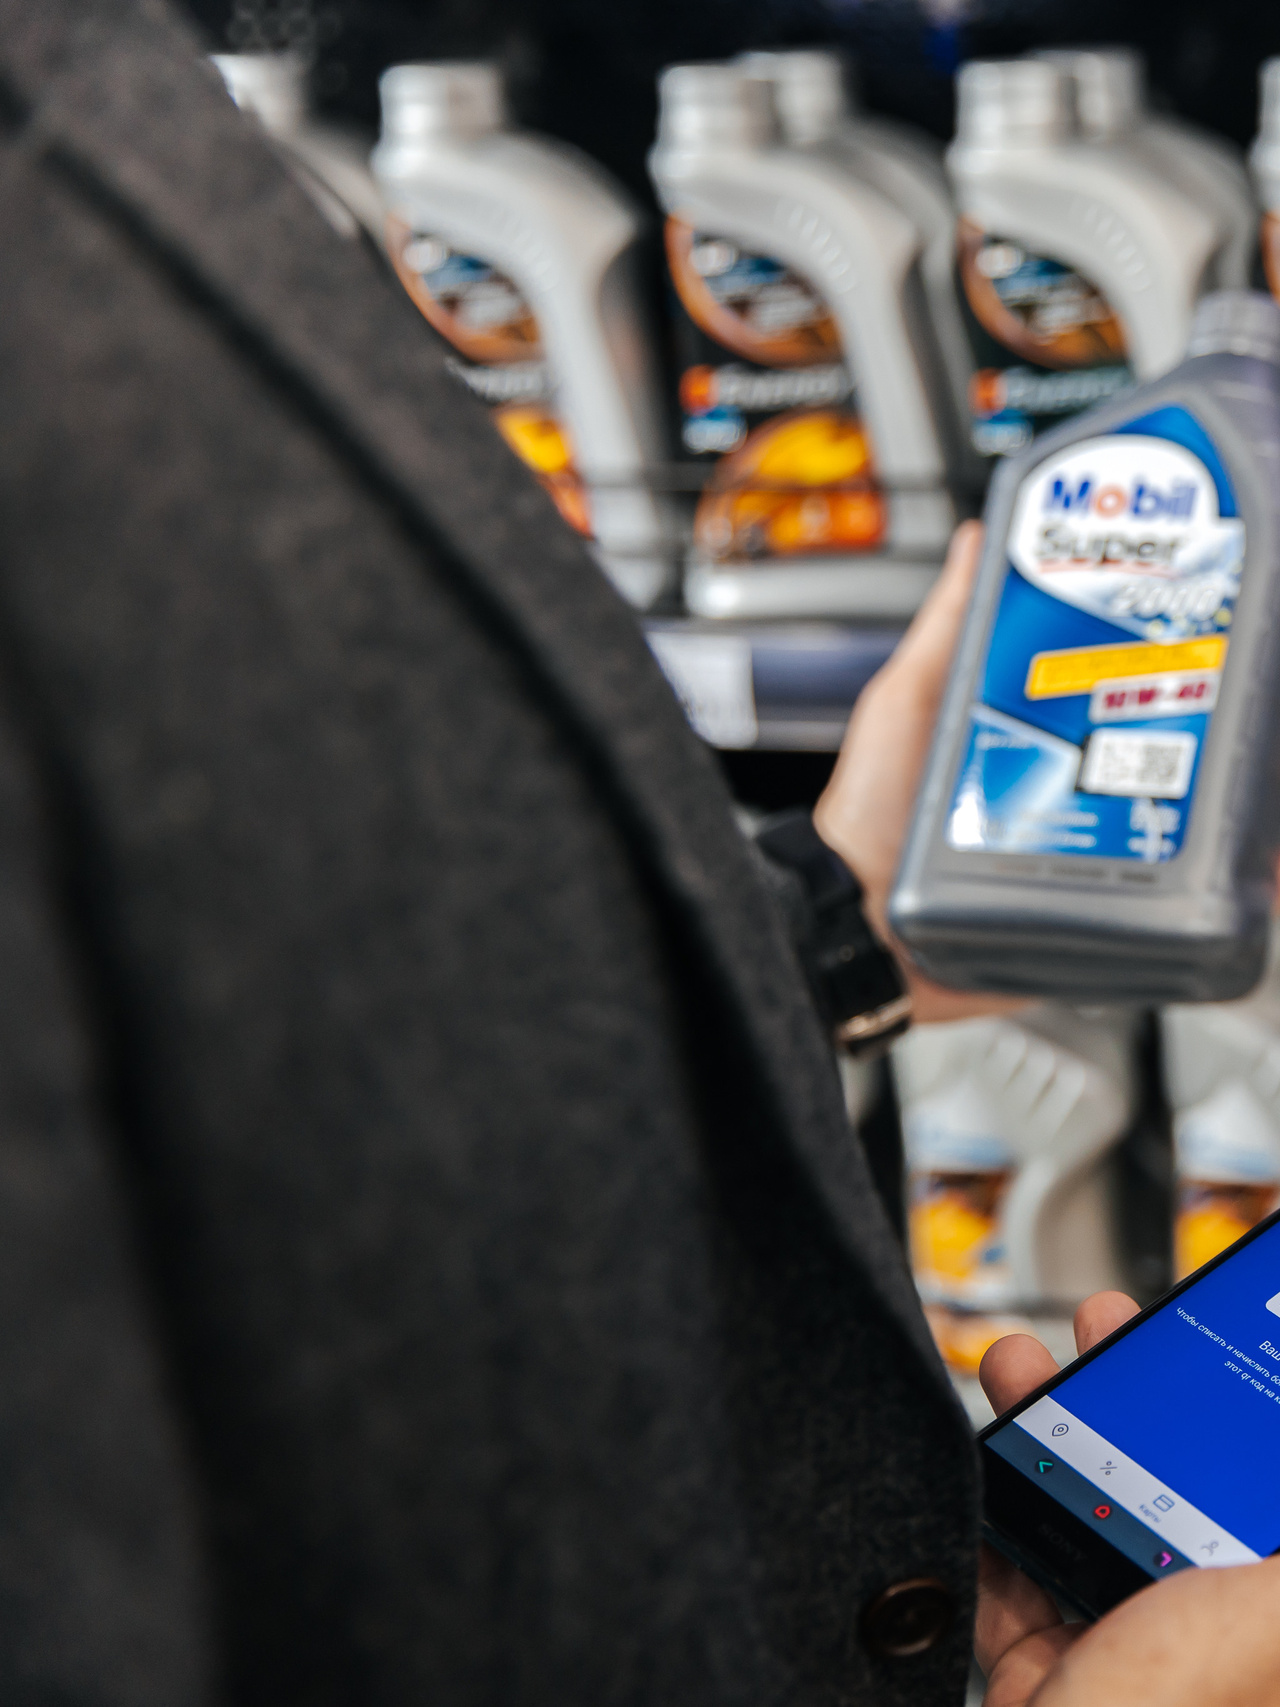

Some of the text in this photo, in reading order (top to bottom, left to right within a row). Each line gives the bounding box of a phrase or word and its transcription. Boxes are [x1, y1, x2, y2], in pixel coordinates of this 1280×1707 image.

[1045, 477, 1198, 519] Mobil
[1038, 522, 1182, 565] Super
[1177, 1307, 1199, 1327] Чтобы
[1198, 1324, 1227, 1347] списать
[1226, 1344, 1234, 1352] и
[1232, 1348, 1270, 1378] начислить
[1224, 1360, 1241, 1375] этот
[1241, 1371, 1251, 1381] qr
[1249, 1379, 1266, 1392] код
[1264, 1387, 1276, 1398] на
[1139, 1503, 1161, 1524] Карты
